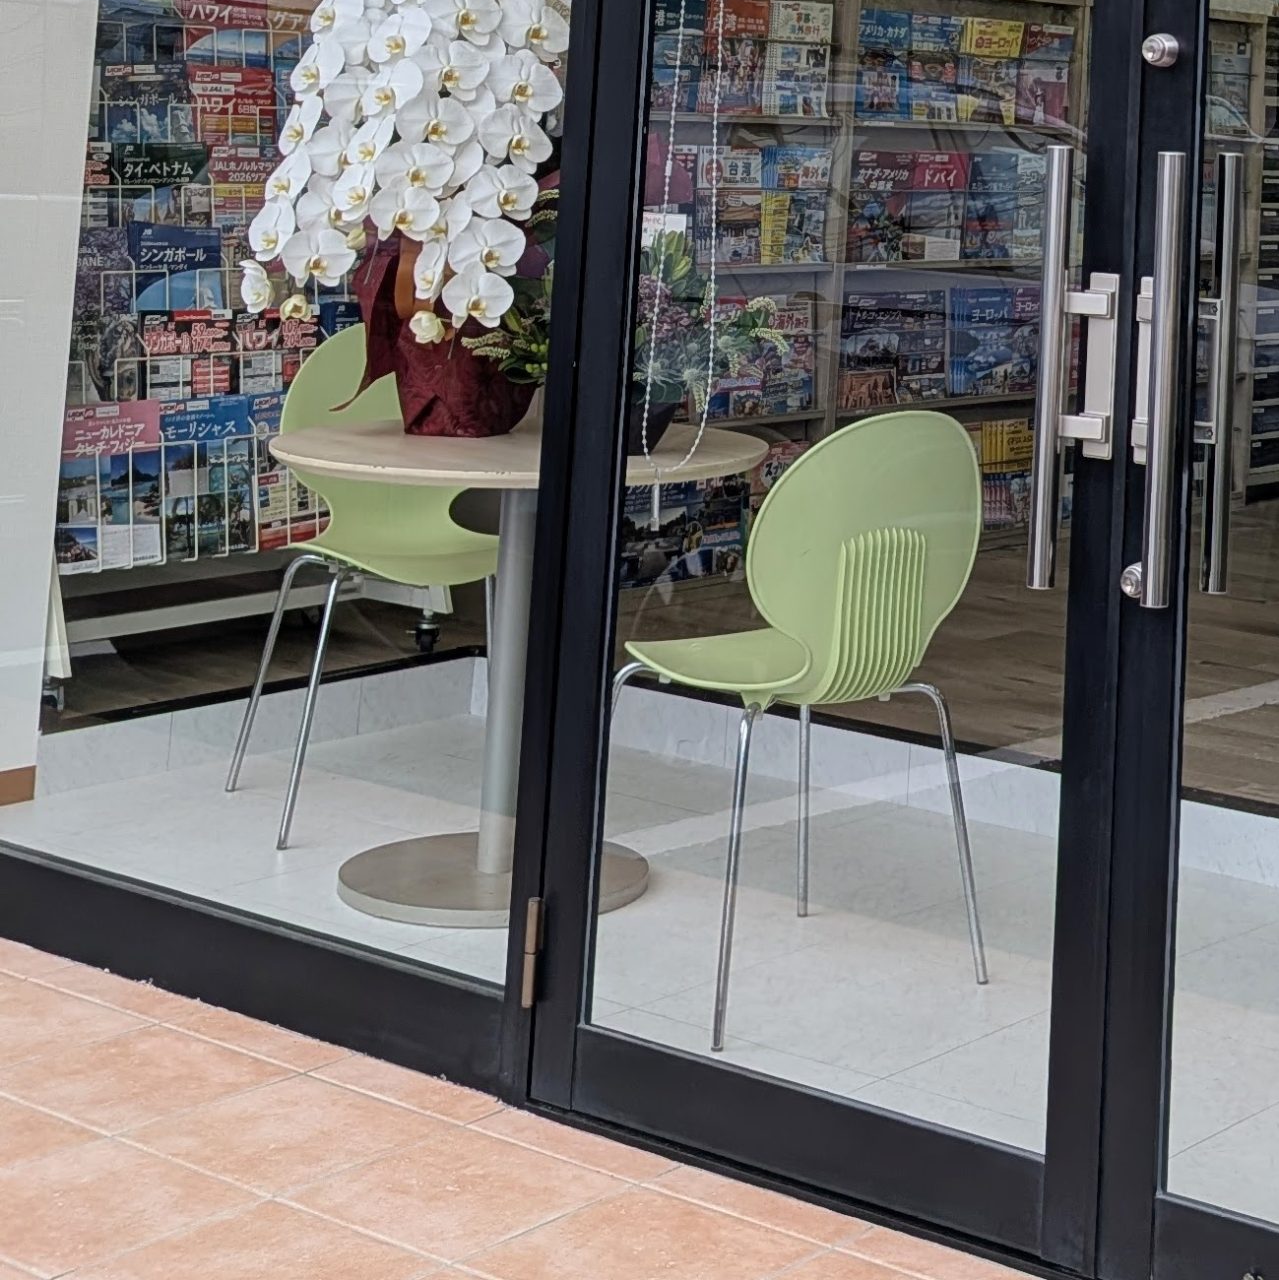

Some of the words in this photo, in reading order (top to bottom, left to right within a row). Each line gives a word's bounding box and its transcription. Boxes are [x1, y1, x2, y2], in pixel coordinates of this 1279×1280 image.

[189, 4, 233, 25] ハワイ
[857, 24, 909, 39] アメリカ・カナダ
[123, 162, 194, 178] タイ・ベトナム
[213, 160, 276, 172] JALホノルルマラ
[728, 160, 752, 178] 台湾
[923, 168, 957, 187] ドバイ
[139, 247, 207, 263] シンガポール
[971, 308, 1009, 322] ヨーロッパ
[74, 423, 145, 441] ニューカレドニア
[164, 420, 237, 440] モーリシャス
